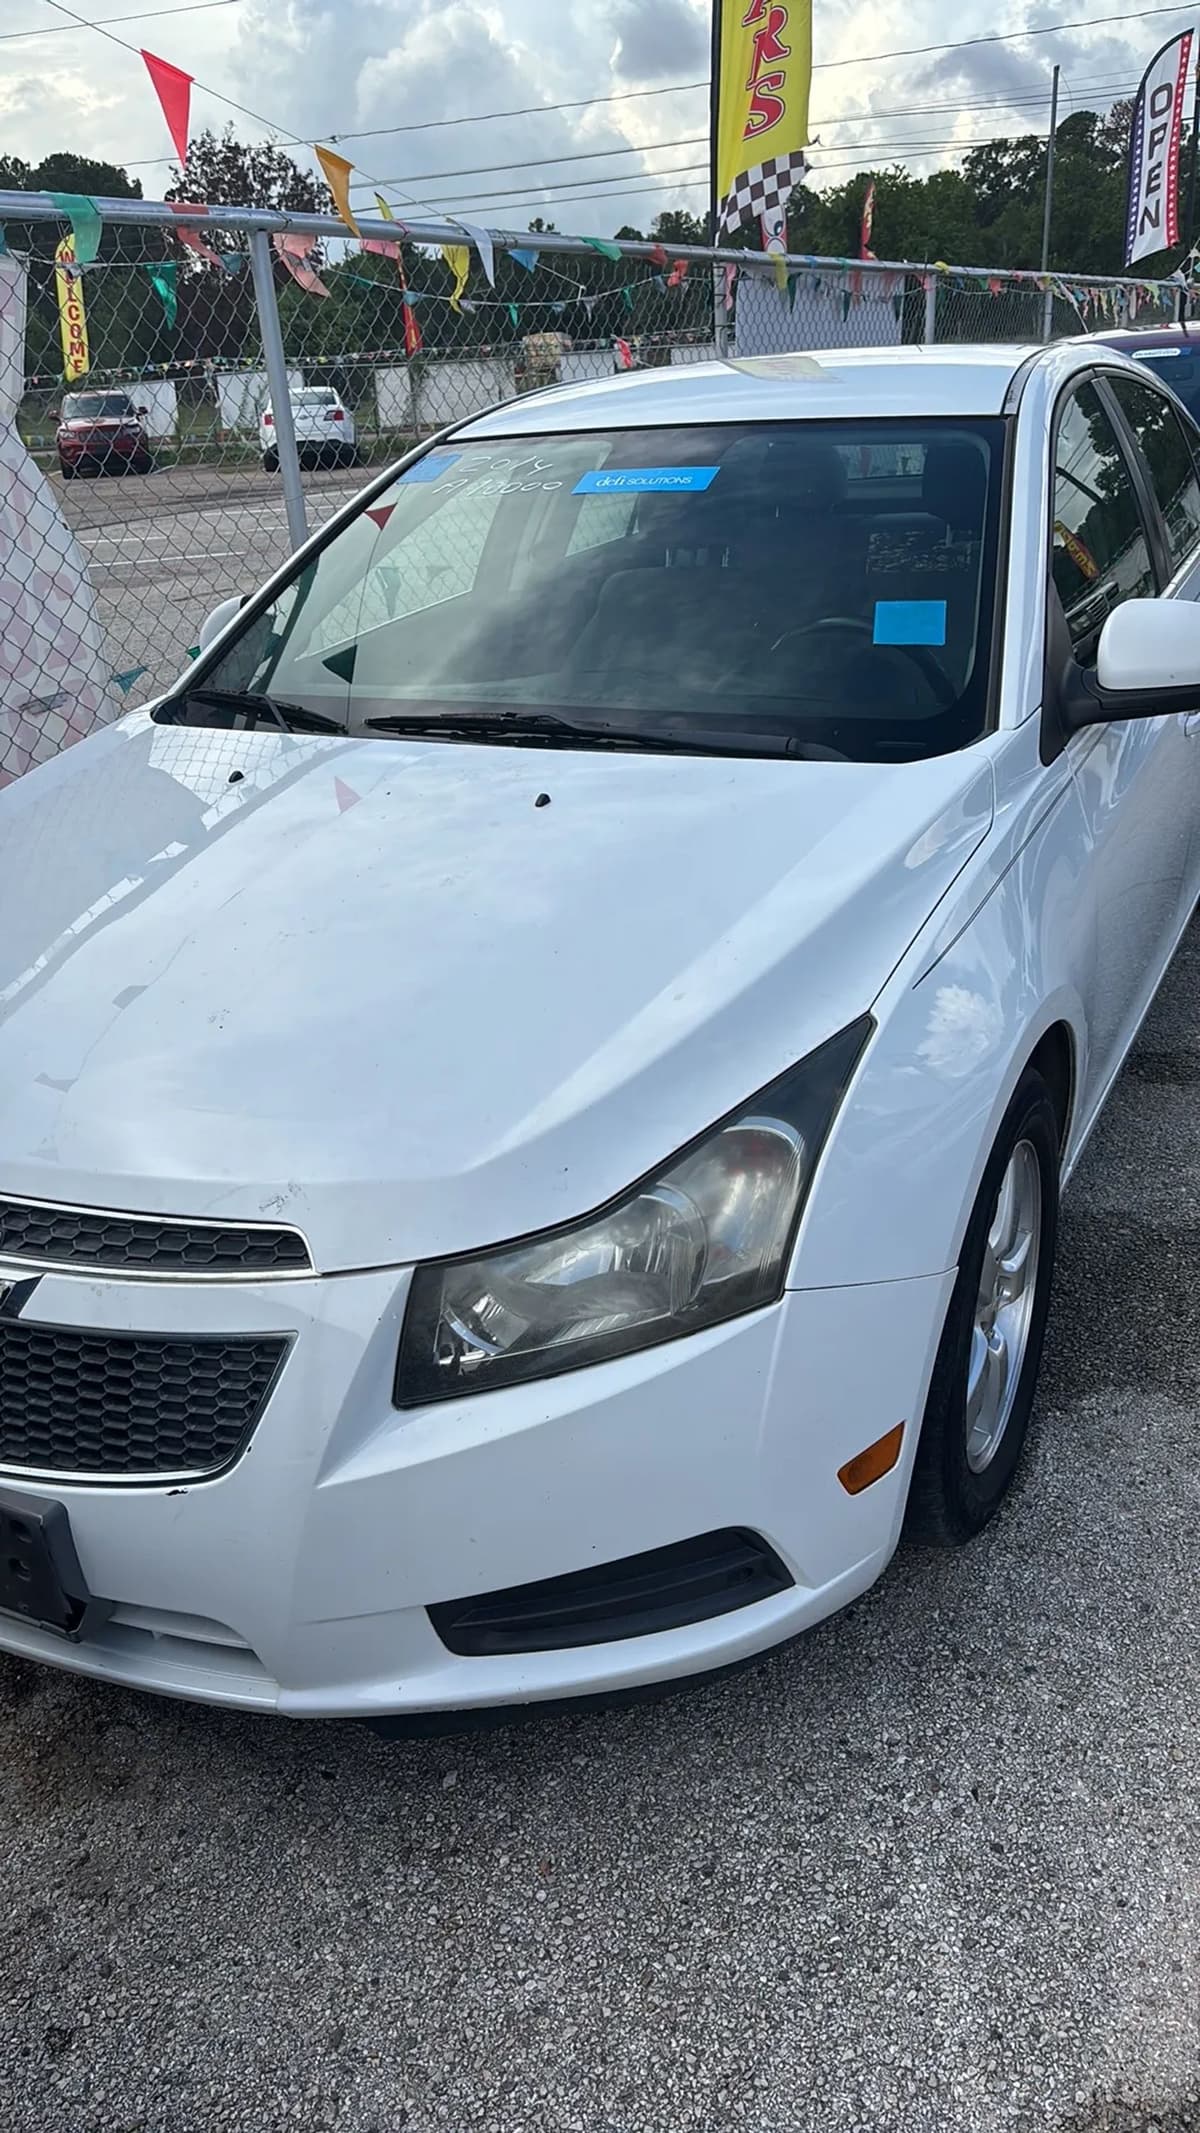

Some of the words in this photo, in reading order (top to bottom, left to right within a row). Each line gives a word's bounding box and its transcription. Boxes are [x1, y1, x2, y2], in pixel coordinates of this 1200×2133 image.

[1139, 82, 1173, 237] OPEN
[459, 455, 553, 476] 2014
[626, 475, 694, 486] SOLUTIONS
